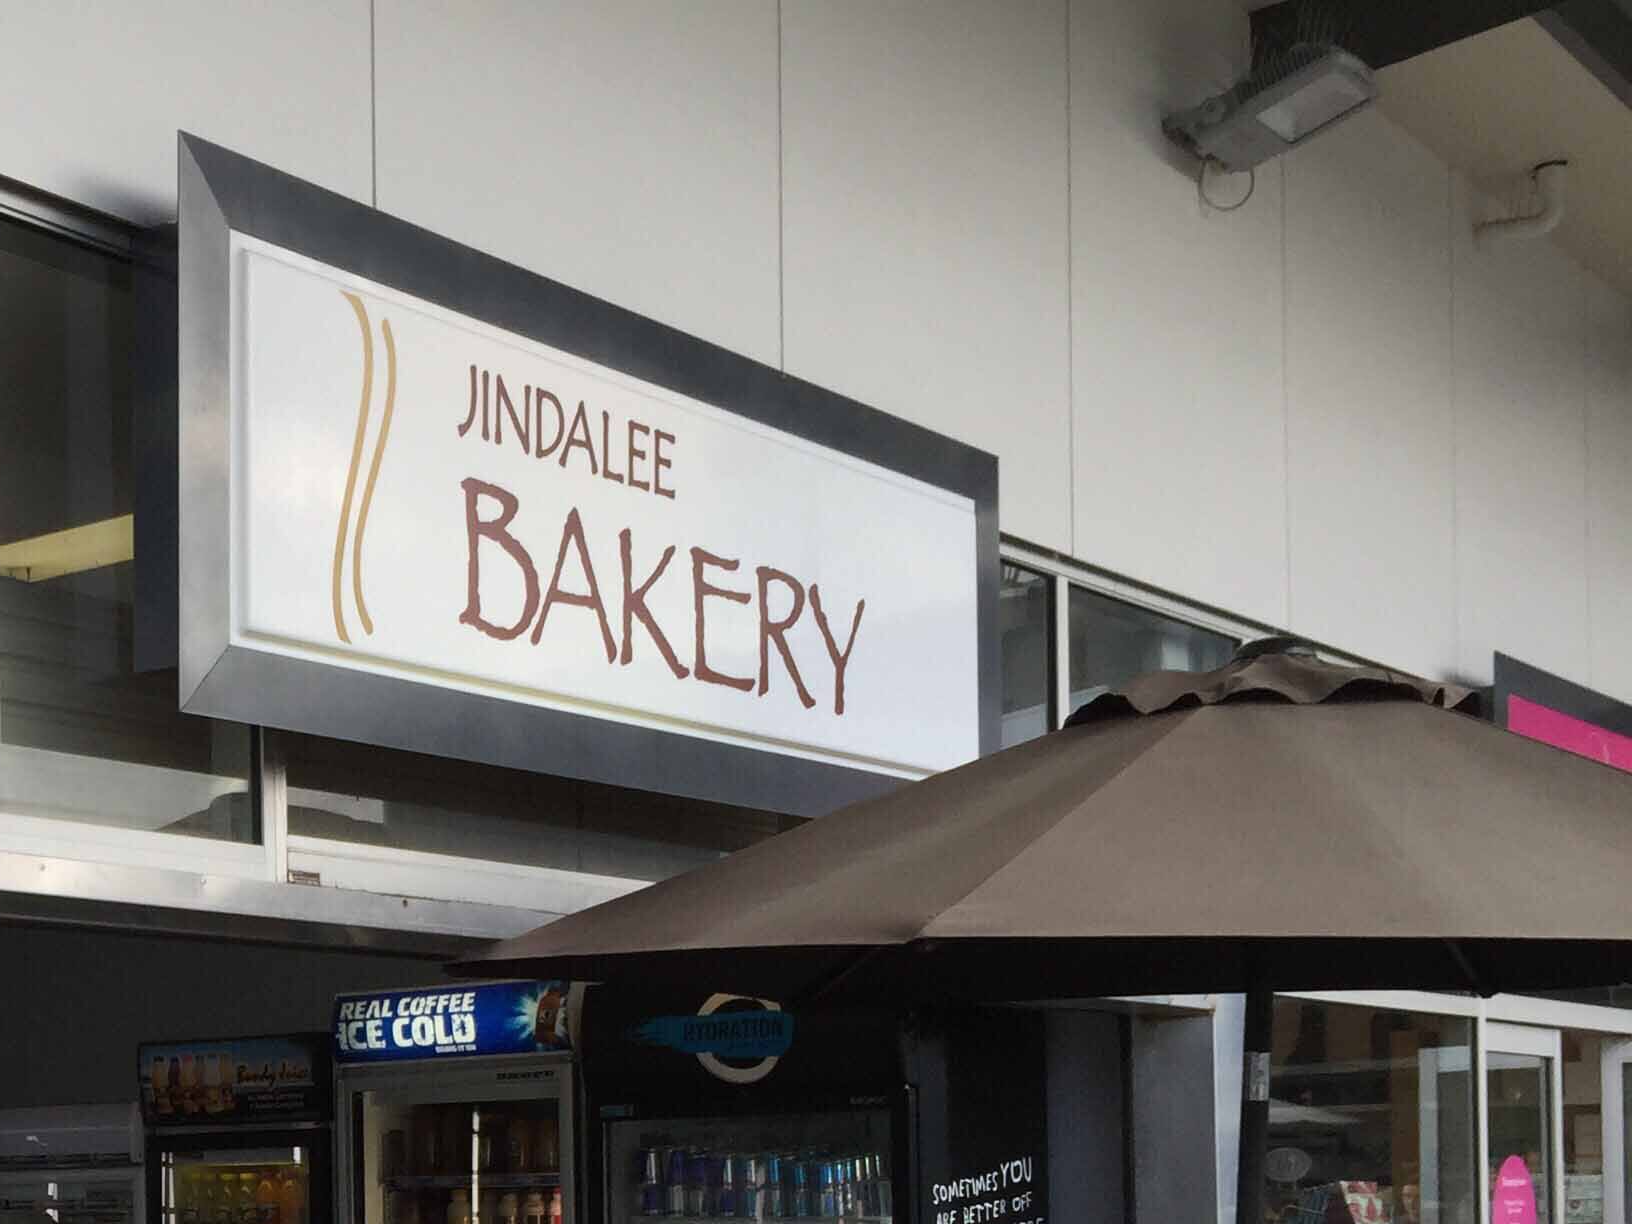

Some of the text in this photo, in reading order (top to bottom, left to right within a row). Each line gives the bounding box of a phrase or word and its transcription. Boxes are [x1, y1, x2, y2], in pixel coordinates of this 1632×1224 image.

[457, 365, 676, 499] JINDALEE
[458, 477, 866, 716] BAKERY
[340, 992, 477, 1021] REAL COFFEE
[336, 1013, 477, 1052] ICE COLD
[932, 1155, 1033, 1205] SOMETIMES YOU
[1011, 1191, 1033, 1213] OFF
